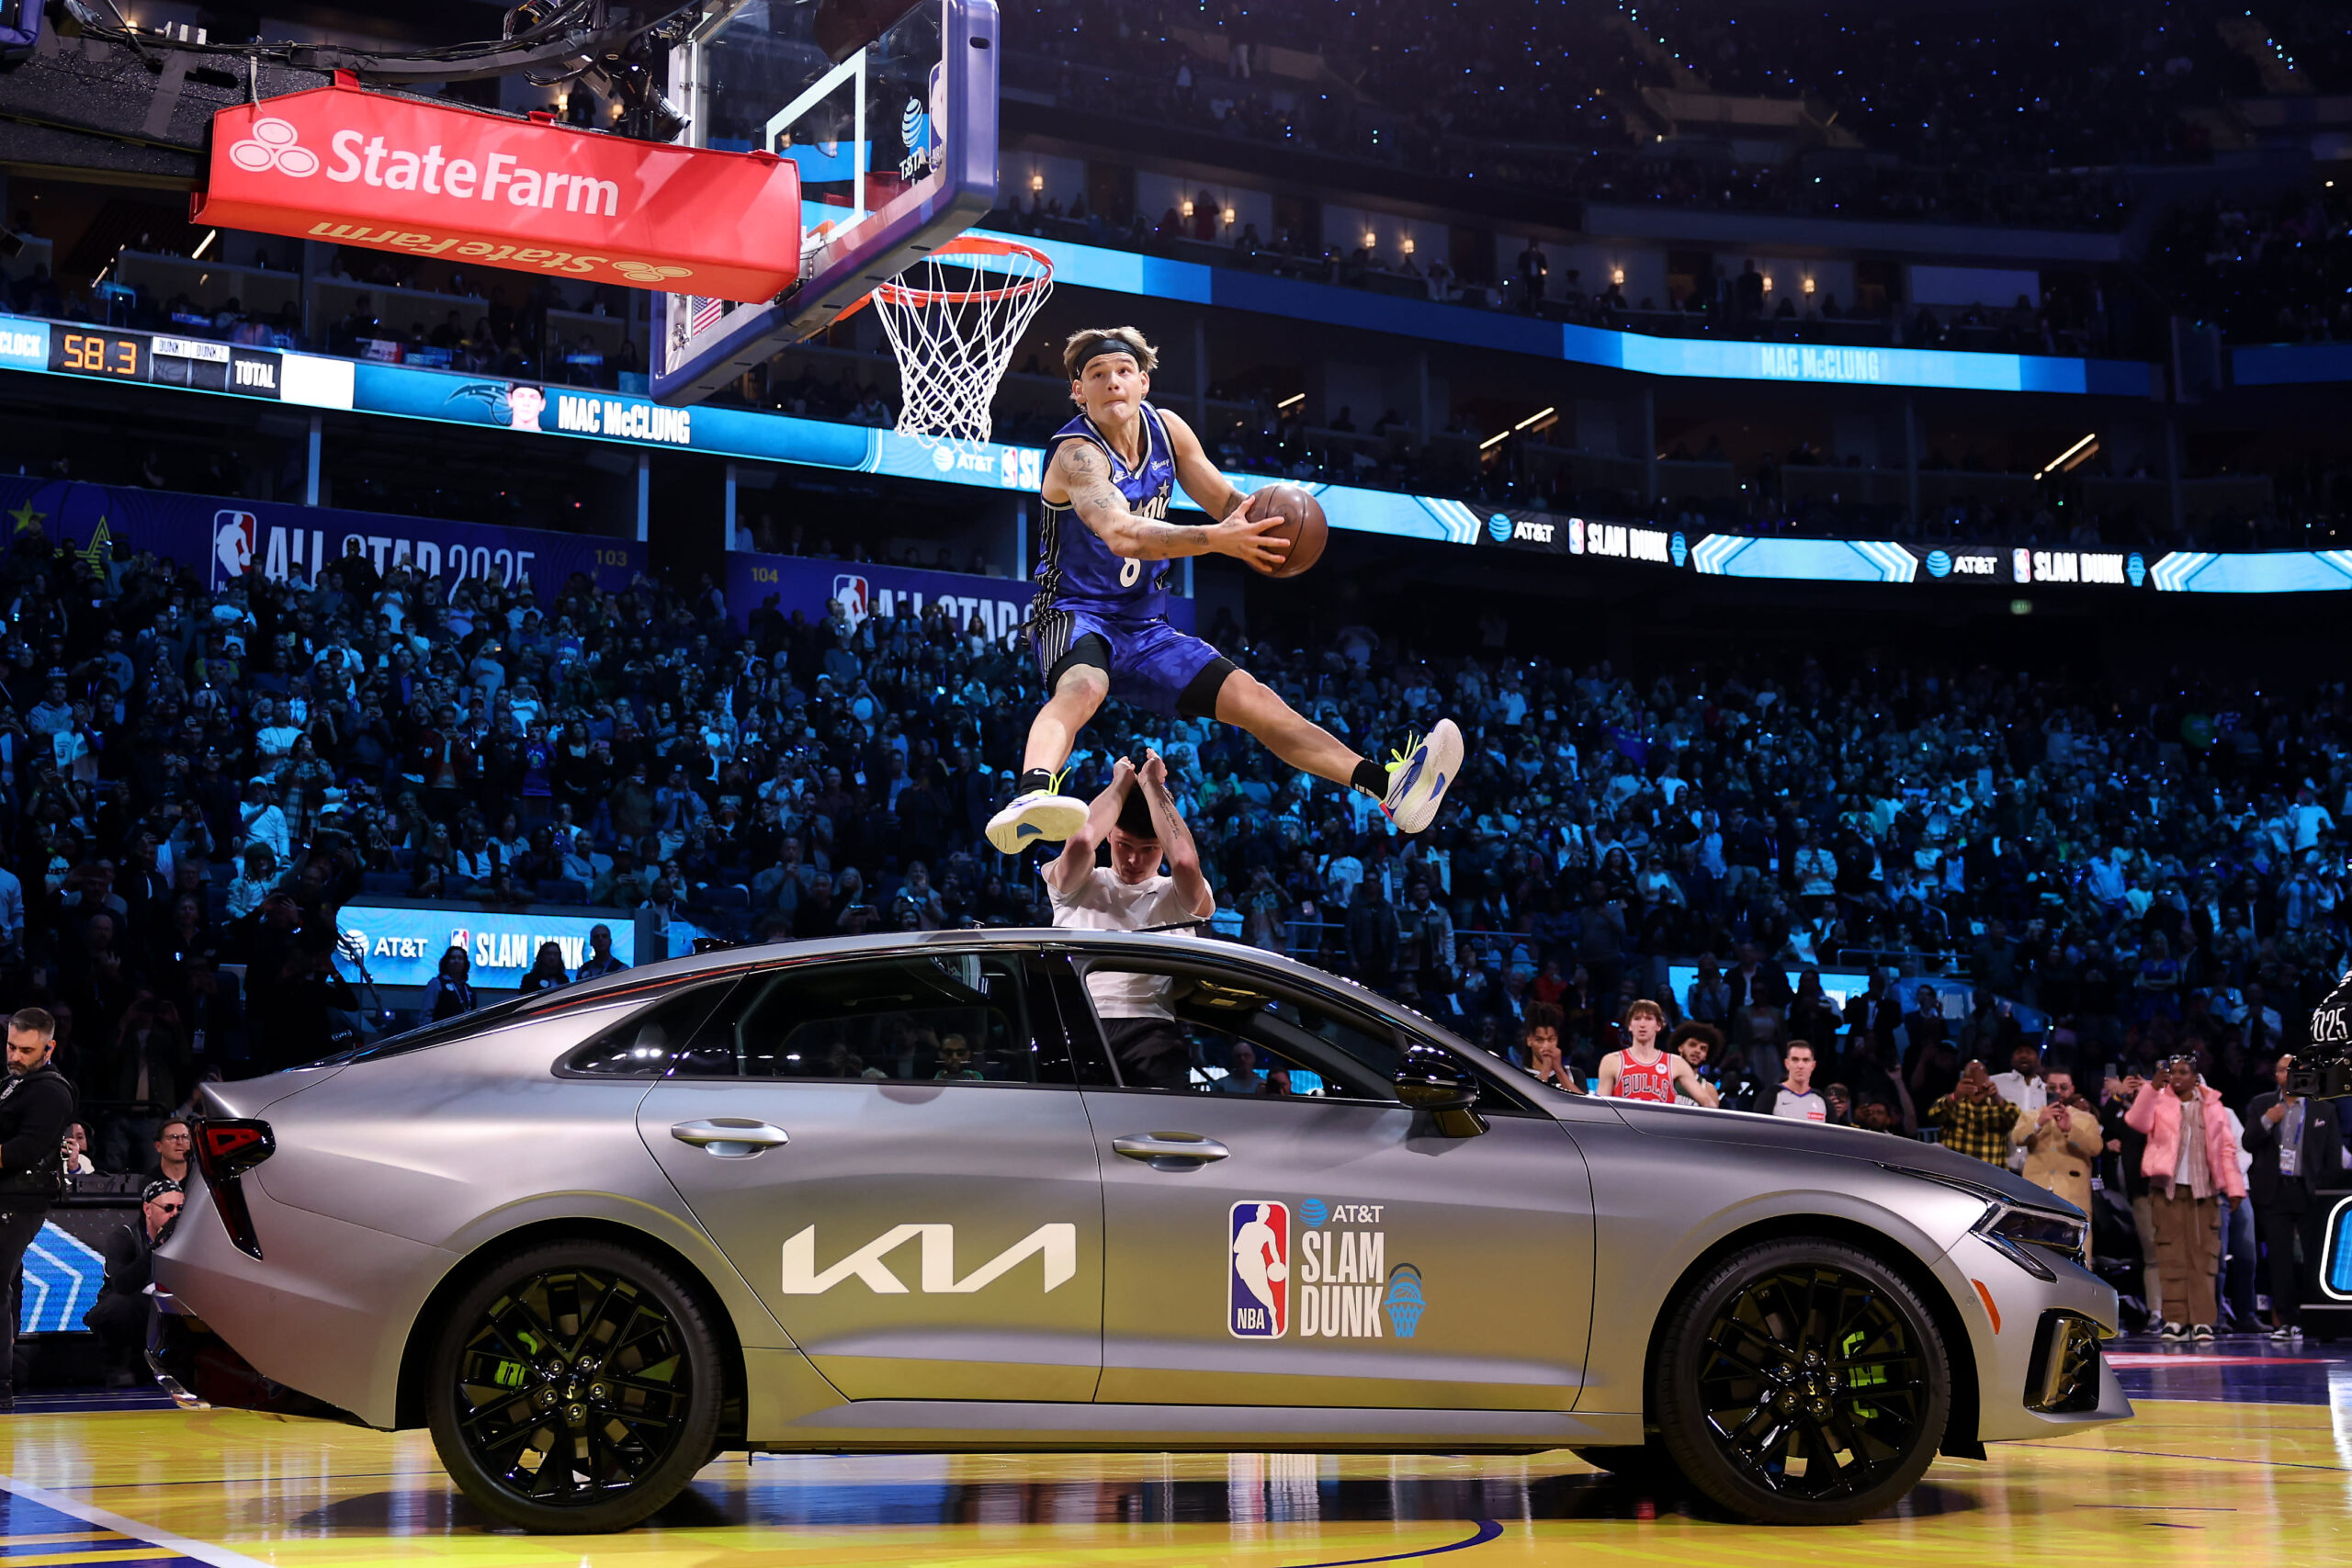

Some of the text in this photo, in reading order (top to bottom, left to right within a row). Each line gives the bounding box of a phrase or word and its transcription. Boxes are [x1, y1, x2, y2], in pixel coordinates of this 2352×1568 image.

[63, 334, 137, 375] 58.3
[159, 339, 179, 354] DUNK
[197, 344, 217, 358] DUNK
[1761, 346, 1879, 381] MAC McCLUNG
[235, 359, 276, 389] TOTAL
[558, 395, 691, 445] MAC McCLUNG
[956, 448, 1042, 491] AT&T SL
[594, 548, 628, 567] 103
[1513, 521, 1669, 563] AT&T SLAM DUNK
[751, 567, 779, 583] 104
[1953, 551, 2125, 584] AT&T SLAM DUNK
[373, 936, 428, 959] AT&T
[475, 932, 527, 968] SLAM
[1623, 1072, 1669, 1102] BULLS
[1332, 1204, 1384, 1224] AT&T
[782, 1223, 1076, 1294] KIA
[1301, 1230, 1385, 1284] SLAM
[1237, 1307, 1265, 1330] NBA
[1300, 1284, 1384, 1337] DUNK
